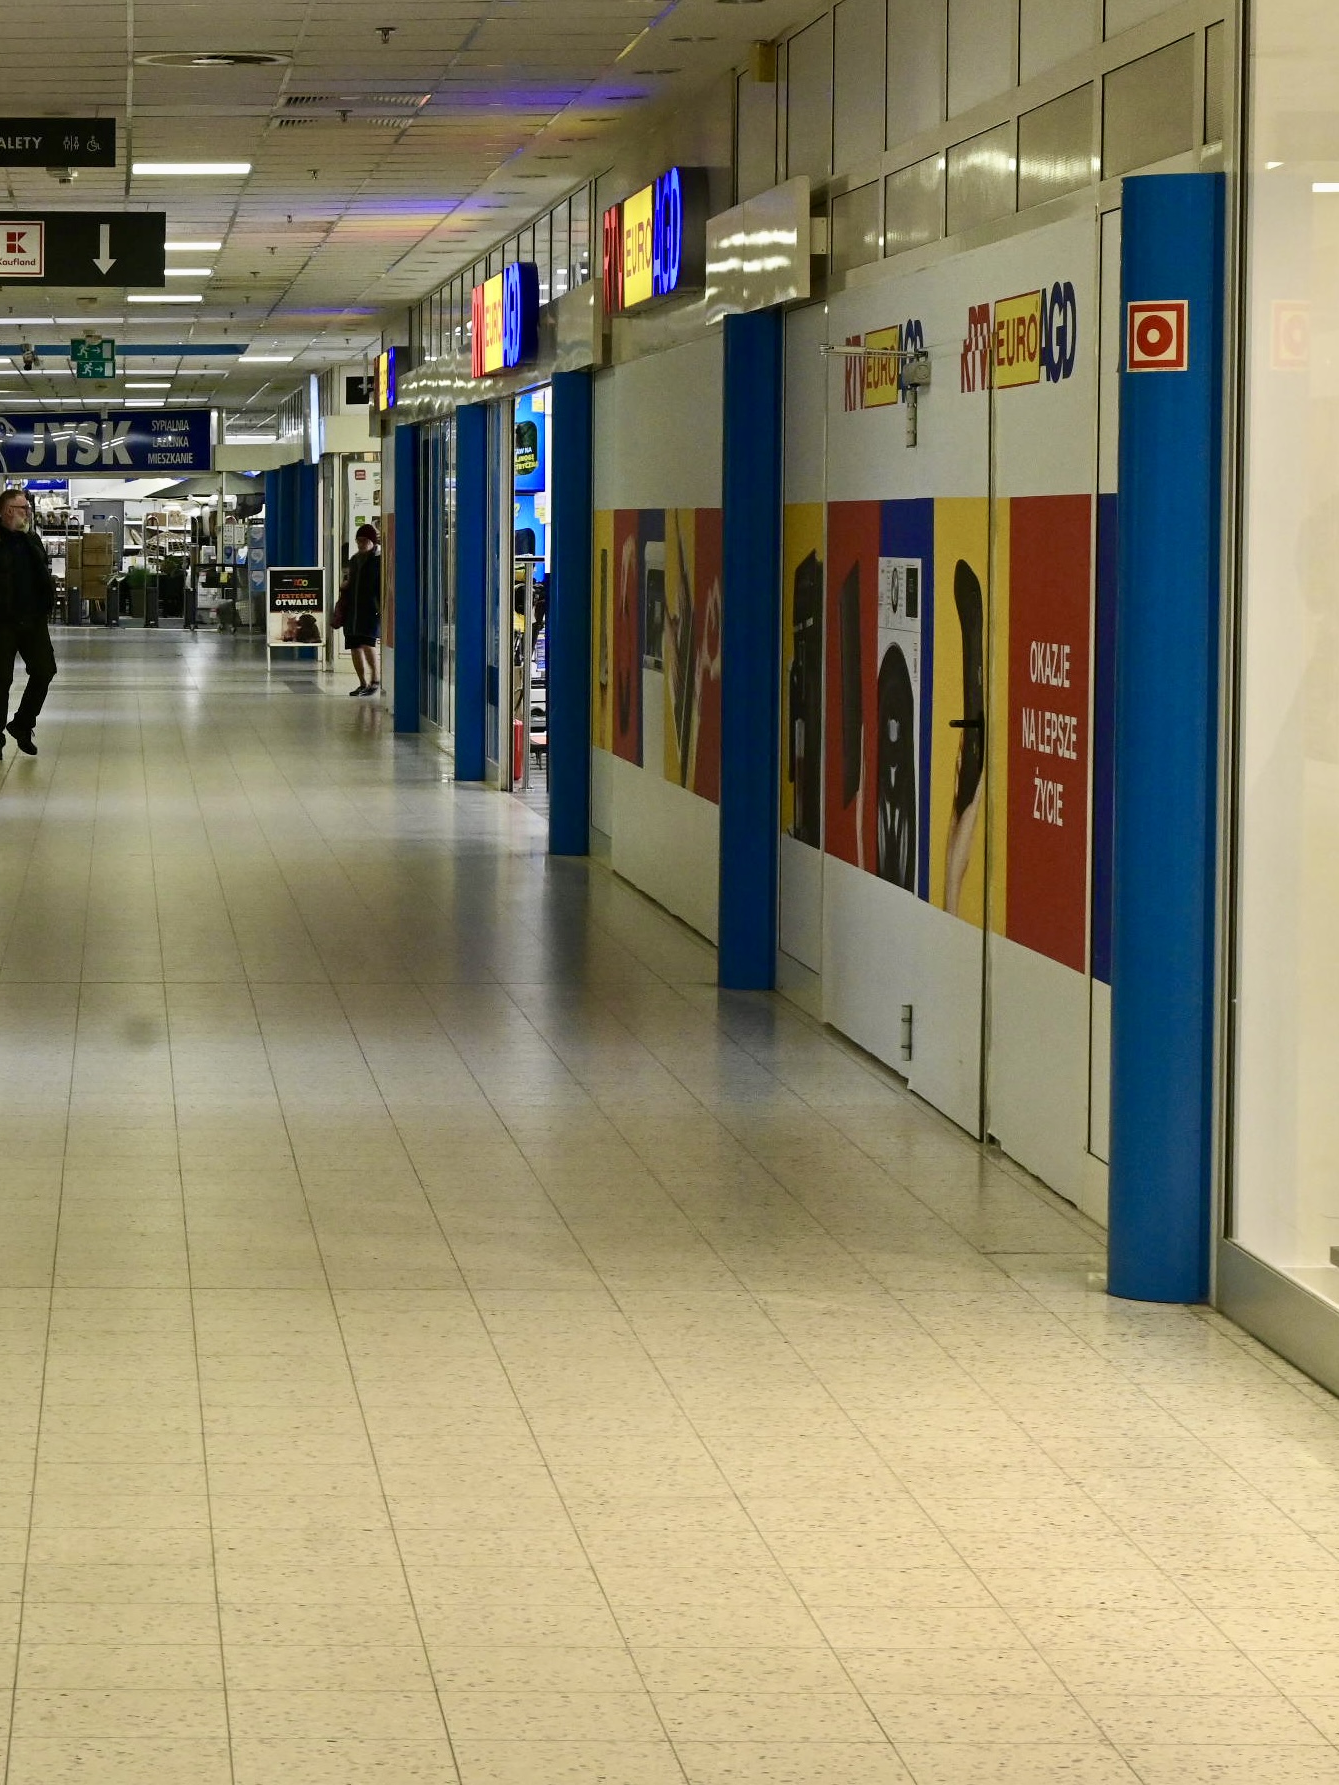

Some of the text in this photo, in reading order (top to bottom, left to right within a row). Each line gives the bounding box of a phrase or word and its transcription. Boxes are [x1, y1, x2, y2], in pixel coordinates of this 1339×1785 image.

[625, 217, 652, 278] EURO
[652, 165, 683, 297] AGD
[961, 281, 1077, 393] RTV EURO AGD
[865, 345, 898, 389] EURO
[25, 420, 133, 466] JYSK
[151, 420, 189, 431] SYPIALNIA
[147, 453, 193, 464] MIESZKANIE
[1030, 640, 1071, 688] OKAZJE
[1022, 707, 1077, 760] NA LEPSZE
[1033, 766, 1064, 827] ŻYCIE
